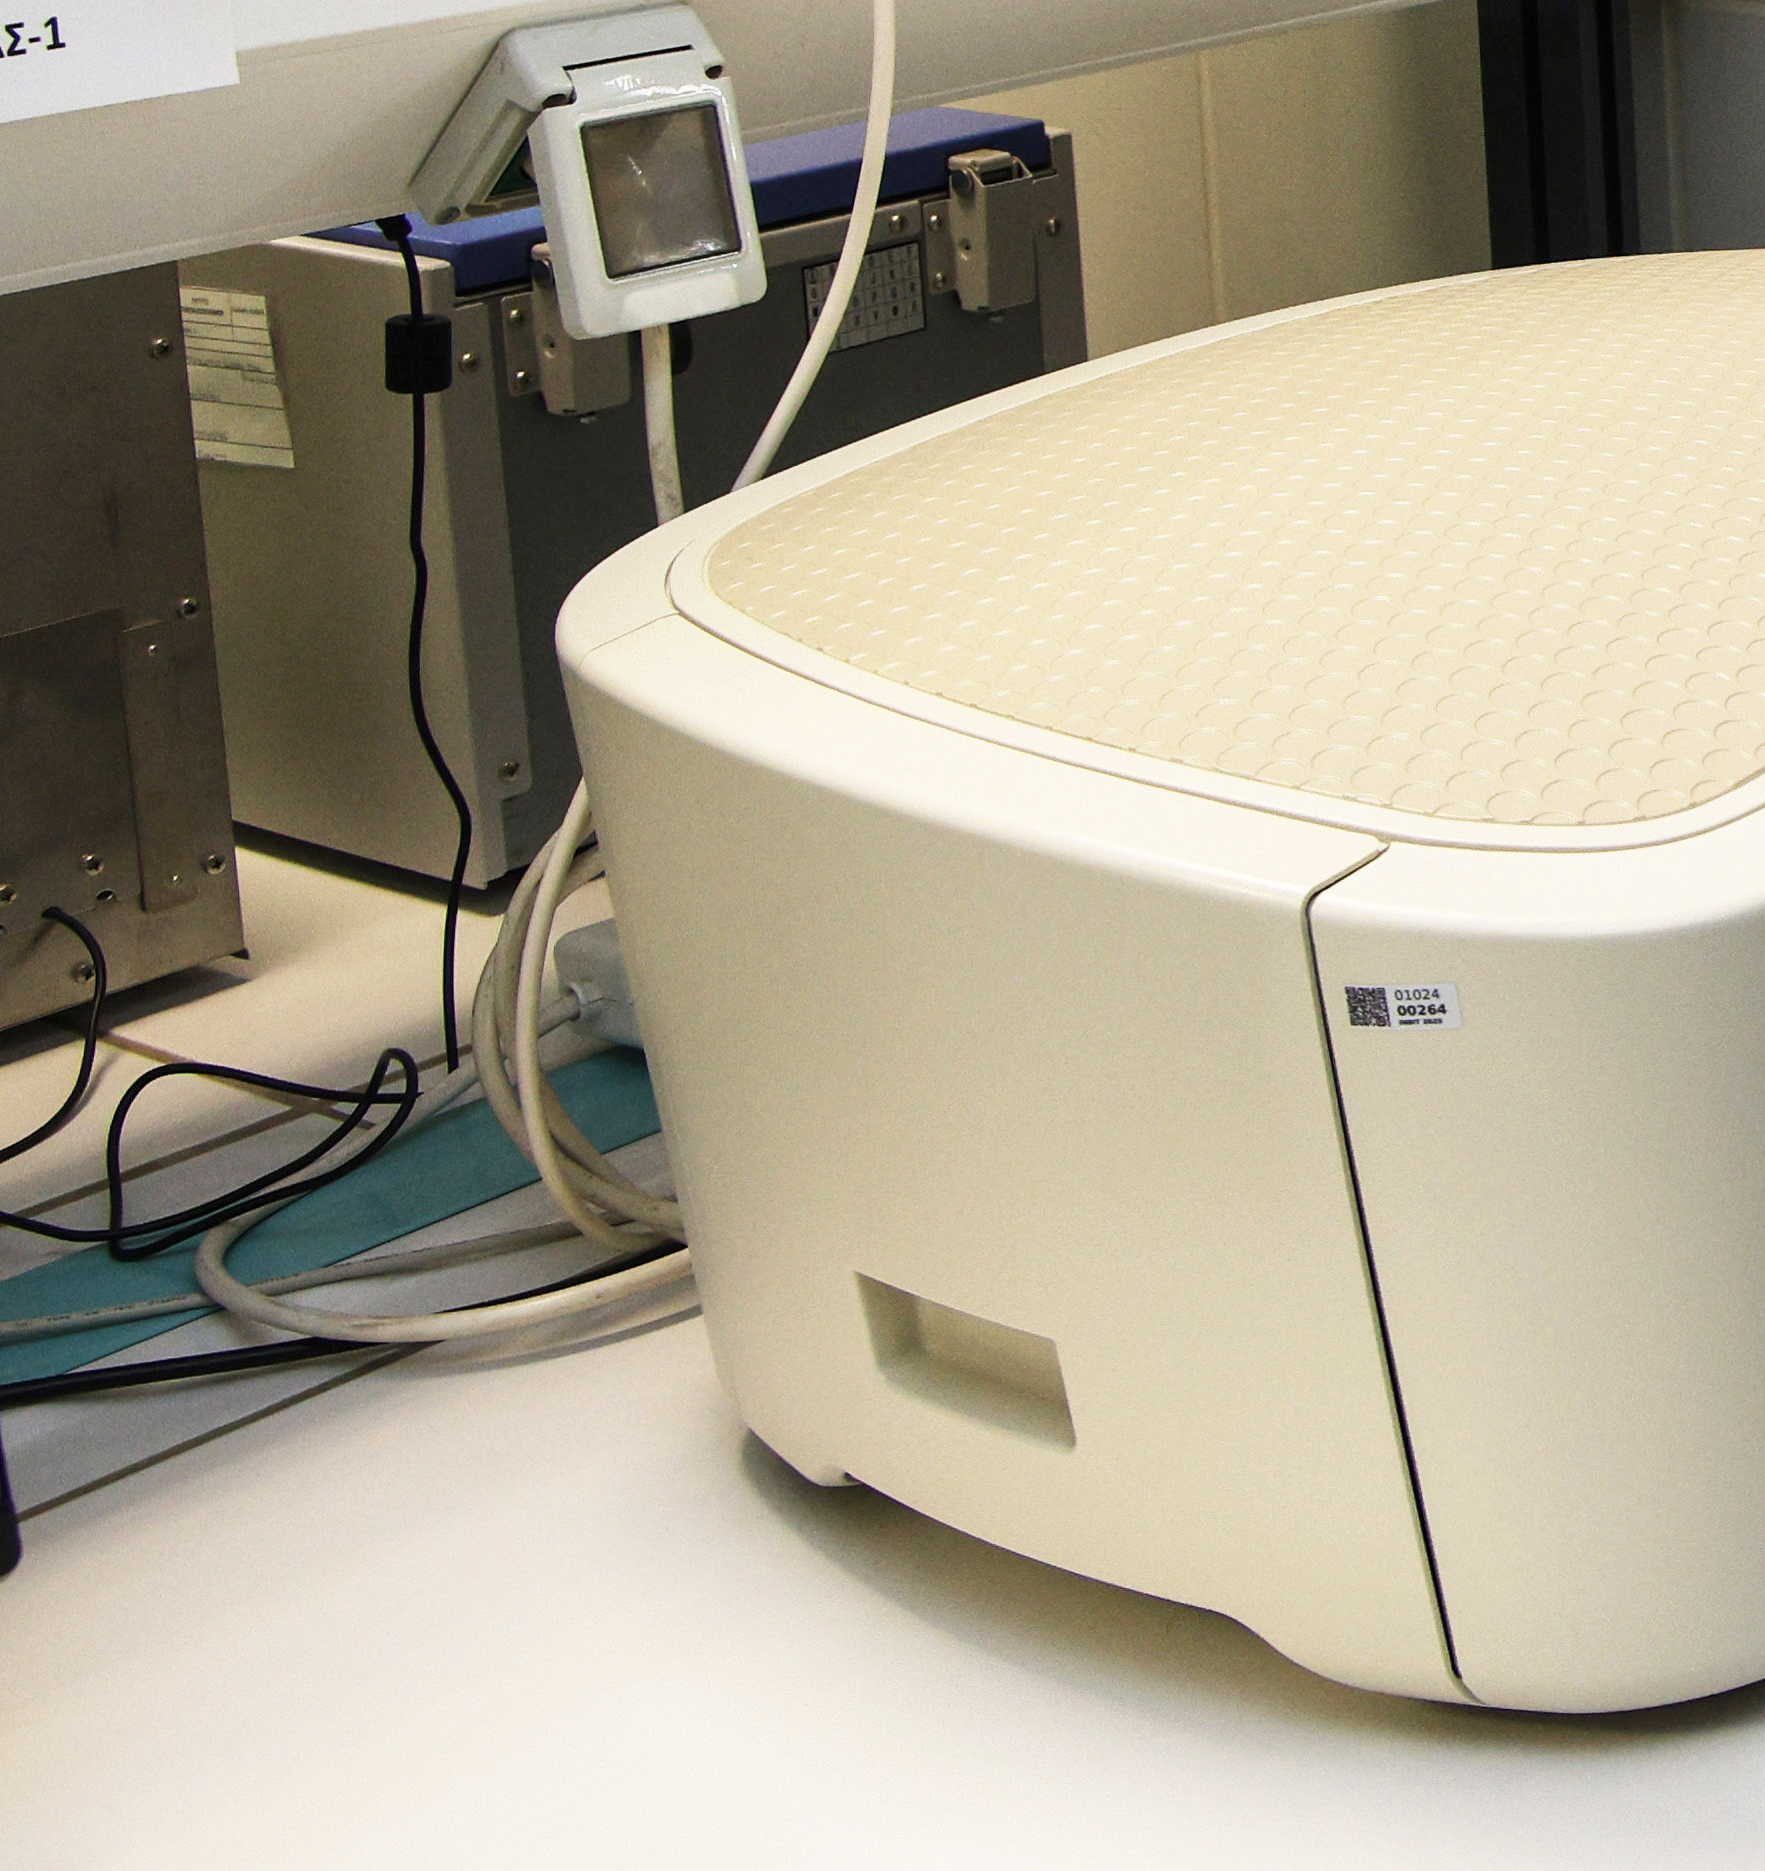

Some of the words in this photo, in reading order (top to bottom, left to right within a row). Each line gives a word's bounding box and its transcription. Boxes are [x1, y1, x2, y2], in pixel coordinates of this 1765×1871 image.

[0, 16, 66, 59] Σ-1
[1394, 988, 1440, 1001] 01024
[1397, 1004, 1447, 1016] 00264
